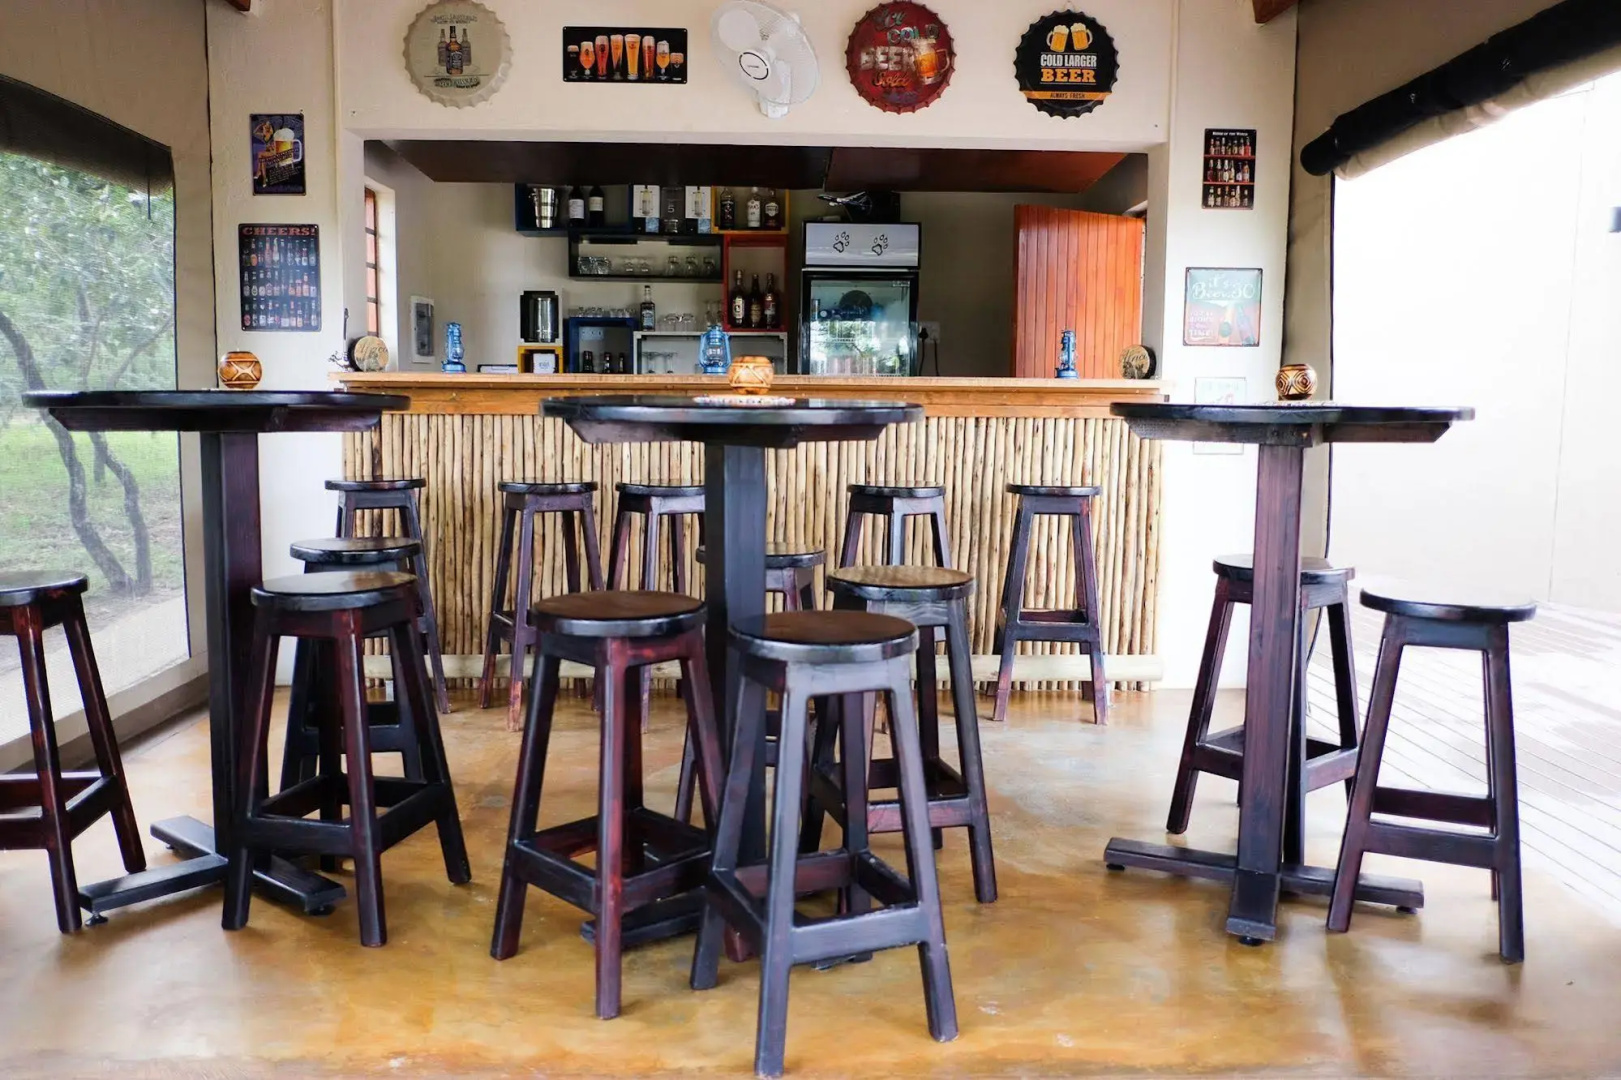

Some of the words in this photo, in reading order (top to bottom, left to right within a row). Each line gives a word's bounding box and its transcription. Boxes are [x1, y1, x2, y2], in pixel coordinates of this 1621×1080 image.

[860, 45, 916, 72] BEER
[1040, 54, 1063, 67] COLD
[1064, 54, 1097, 68] LARGER
[1040, 68, 1097, 83] BEER
[242, 226, 316, 236] CHEERS!
